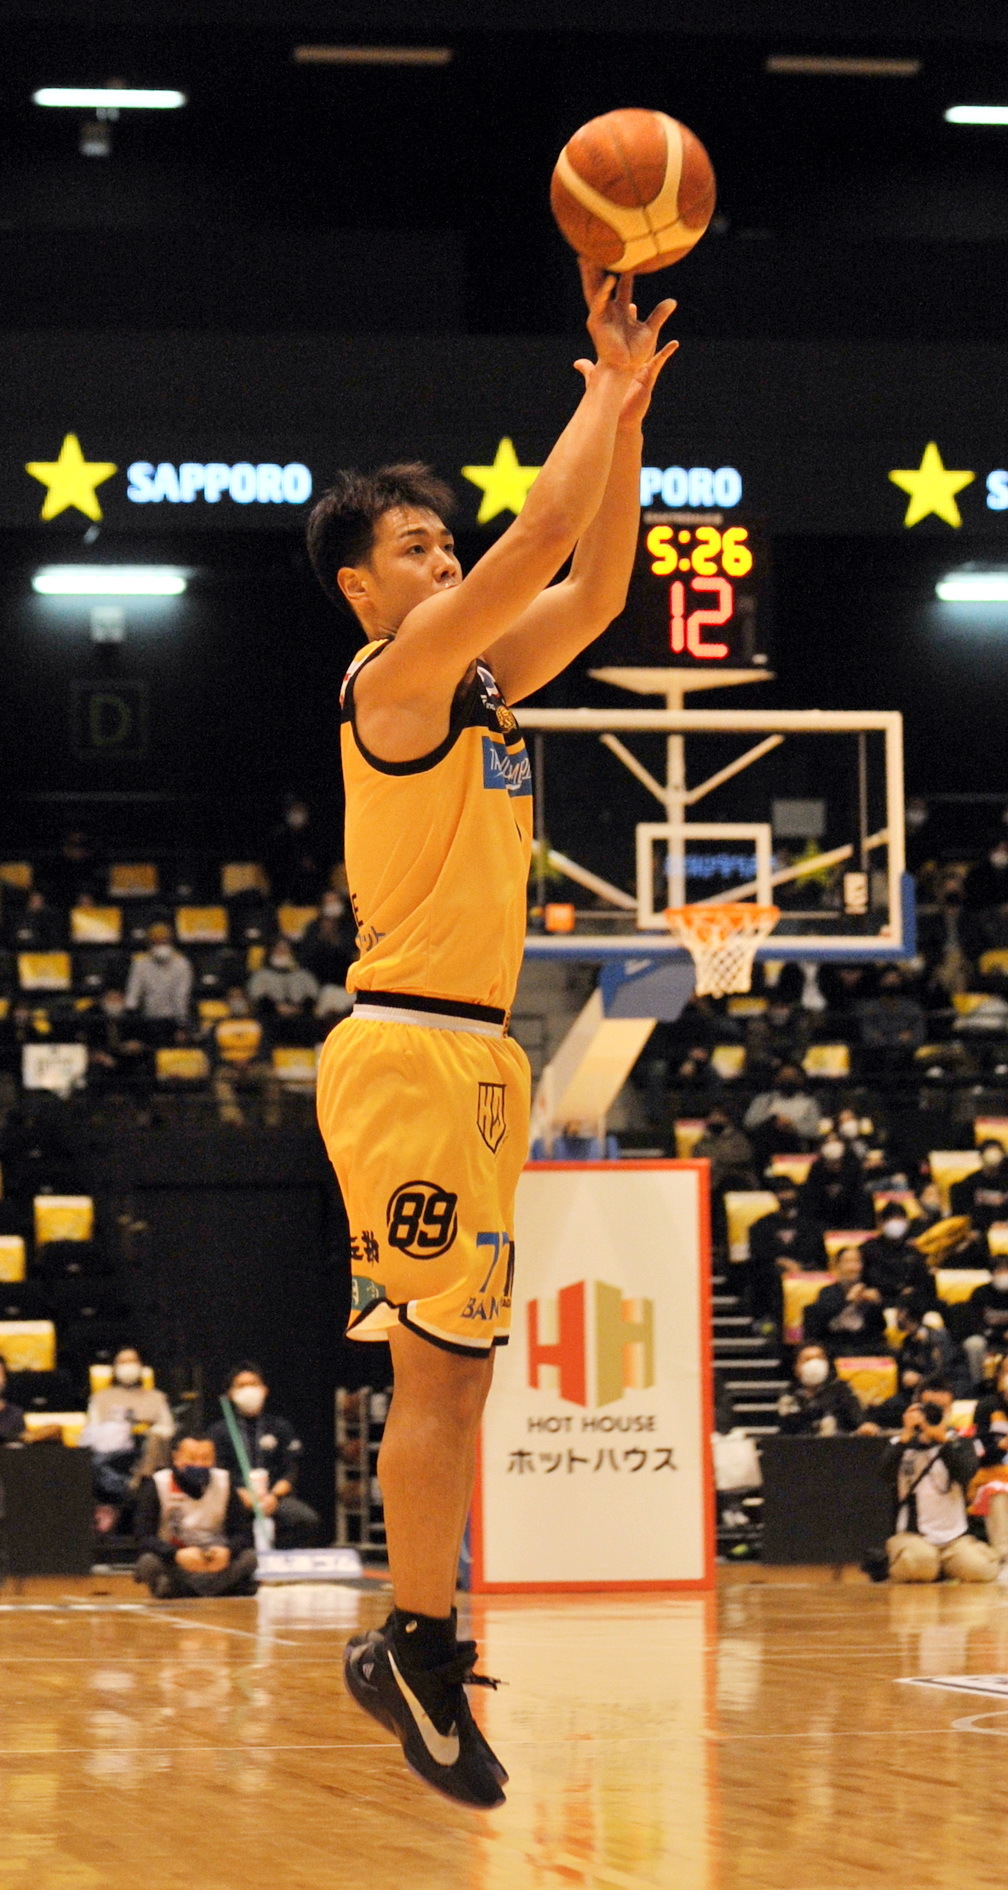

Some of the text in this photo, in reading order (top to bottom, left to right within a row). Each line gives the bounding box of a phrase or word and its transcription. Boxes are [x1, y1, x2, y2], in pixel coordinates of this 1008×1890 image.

[127, 461, 312, 504] SAPPORO
[647, 525, 752, 577] 5:26
[670, 576, 733, 659] 12
[388, 1192, 458, 1248] 89
[527, 1415, 656, 1433] HOT HOUSE
[507, 1447, 678, 1474] ホットハウス
